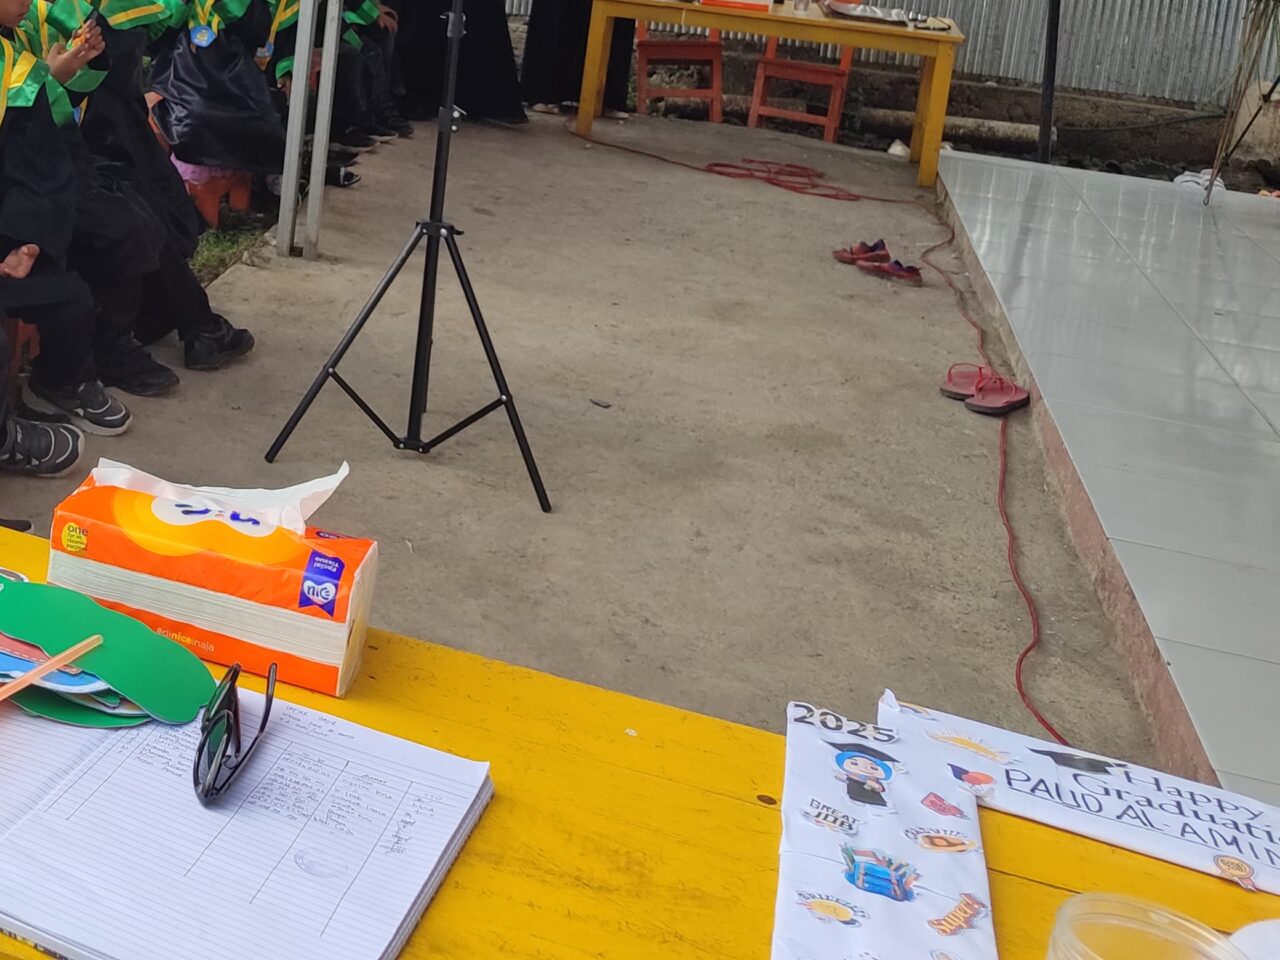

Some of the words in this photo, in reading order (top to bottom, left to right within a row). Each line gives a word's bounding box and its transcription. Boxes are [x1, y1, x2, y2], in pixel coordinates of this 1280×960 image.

[67, 524, 89, 536] one
[792, 703, 897, 743] 2025
[809, 798, 861, 824] GREAT
[1004, 768, 1104, 813] PAUD
[1073, 772, 1280, 845] Graduati
[1123, 769, 1265, 820] Happy
